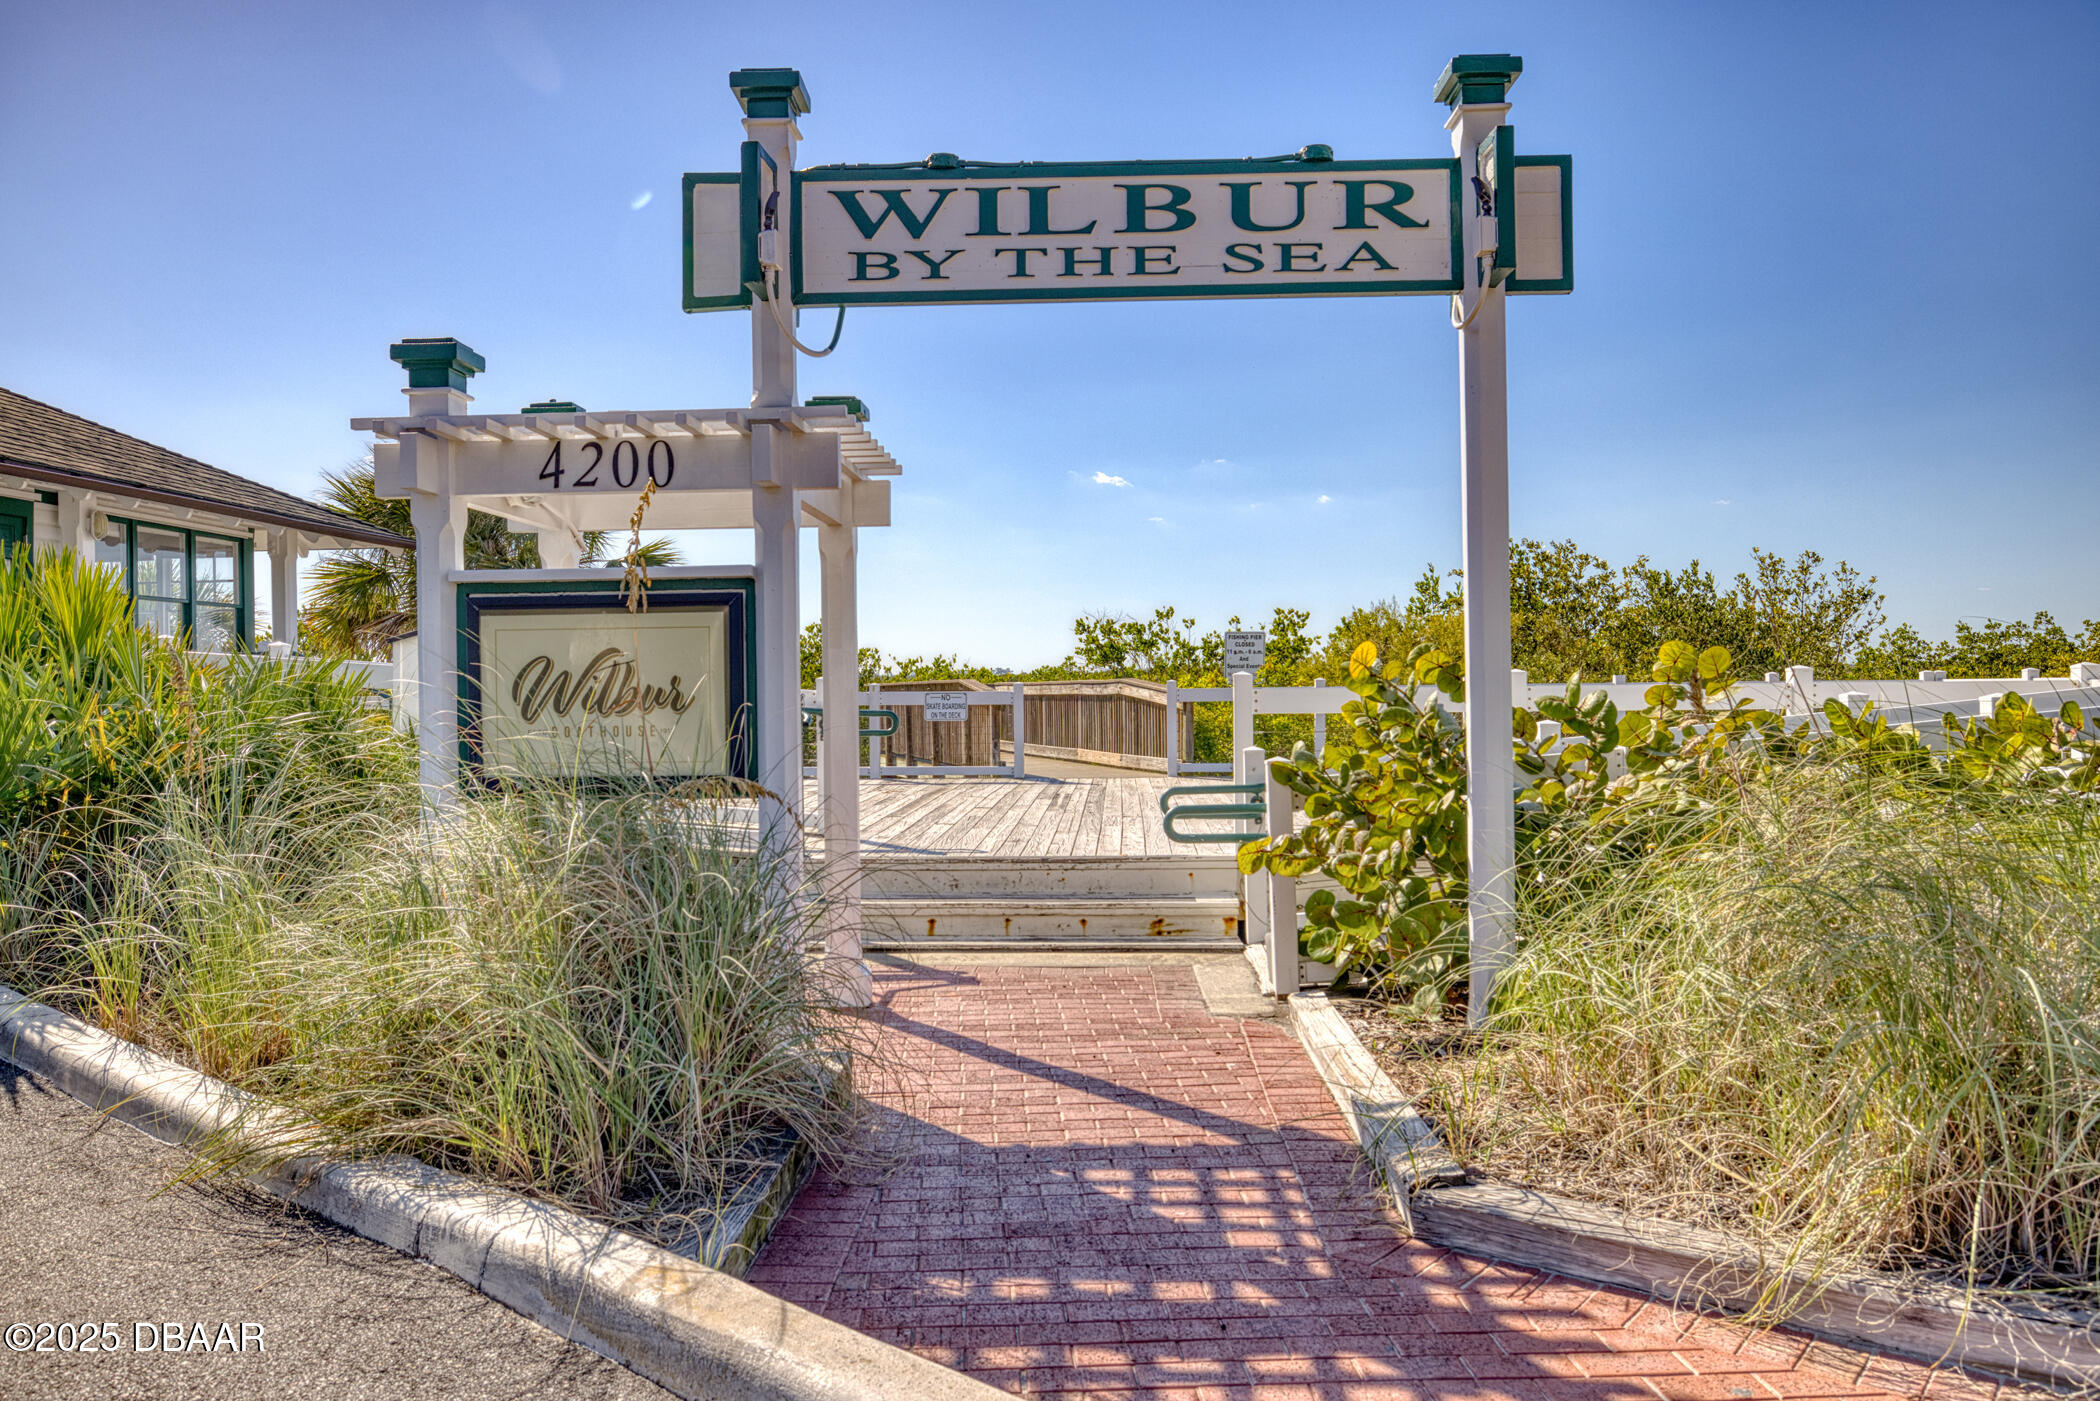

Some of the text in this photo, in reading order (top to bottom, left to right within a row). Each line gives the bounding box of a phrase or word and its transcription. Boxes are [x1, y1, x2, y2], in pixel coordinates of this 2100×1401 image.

[827, 178, 1430, 240] WILBUR
[847, 240, 1400, 281] BY THE SEA
[539, 440, 675, 489] 4200
[511, 646, 696, 724] Wilbur
[930, 711, 961, 719] ON THE DECK
